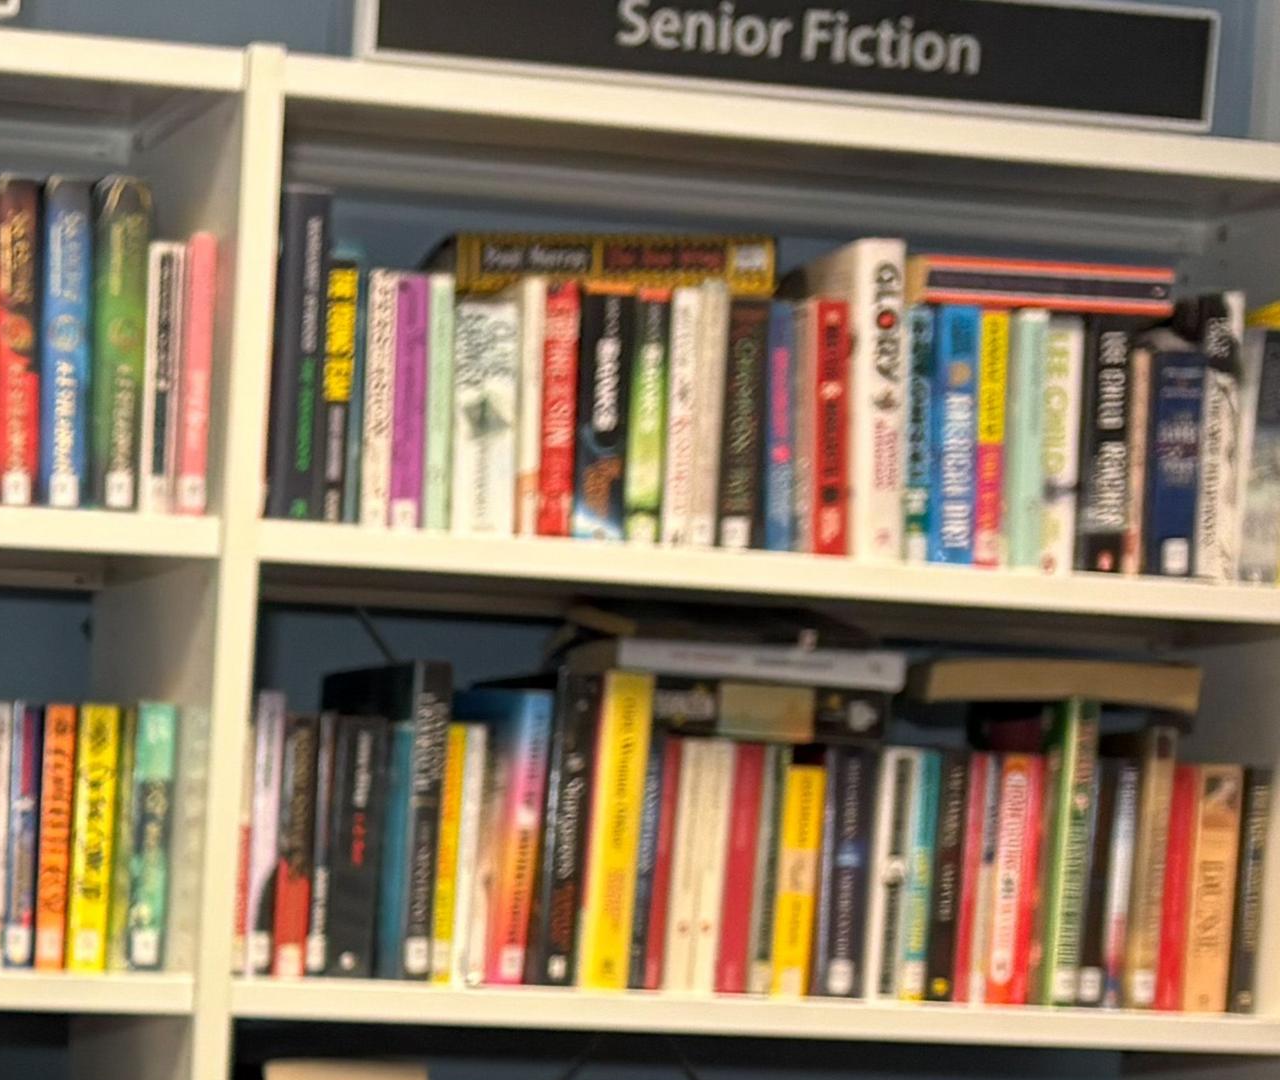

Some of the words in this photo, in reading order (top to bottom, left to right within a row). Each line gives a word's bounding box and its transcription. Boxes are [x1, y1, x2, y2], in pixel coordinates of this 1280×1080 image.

[616, 0, 792, 57] Senior
[801, 8, 981, 75] Fiction
[874, 263, 902, 384] GLORY
[943, 392, 973, 496] AMERICAN
[941, 499, 970, 549] DIRT
[1199, 860, 1226, 954] DUNE
